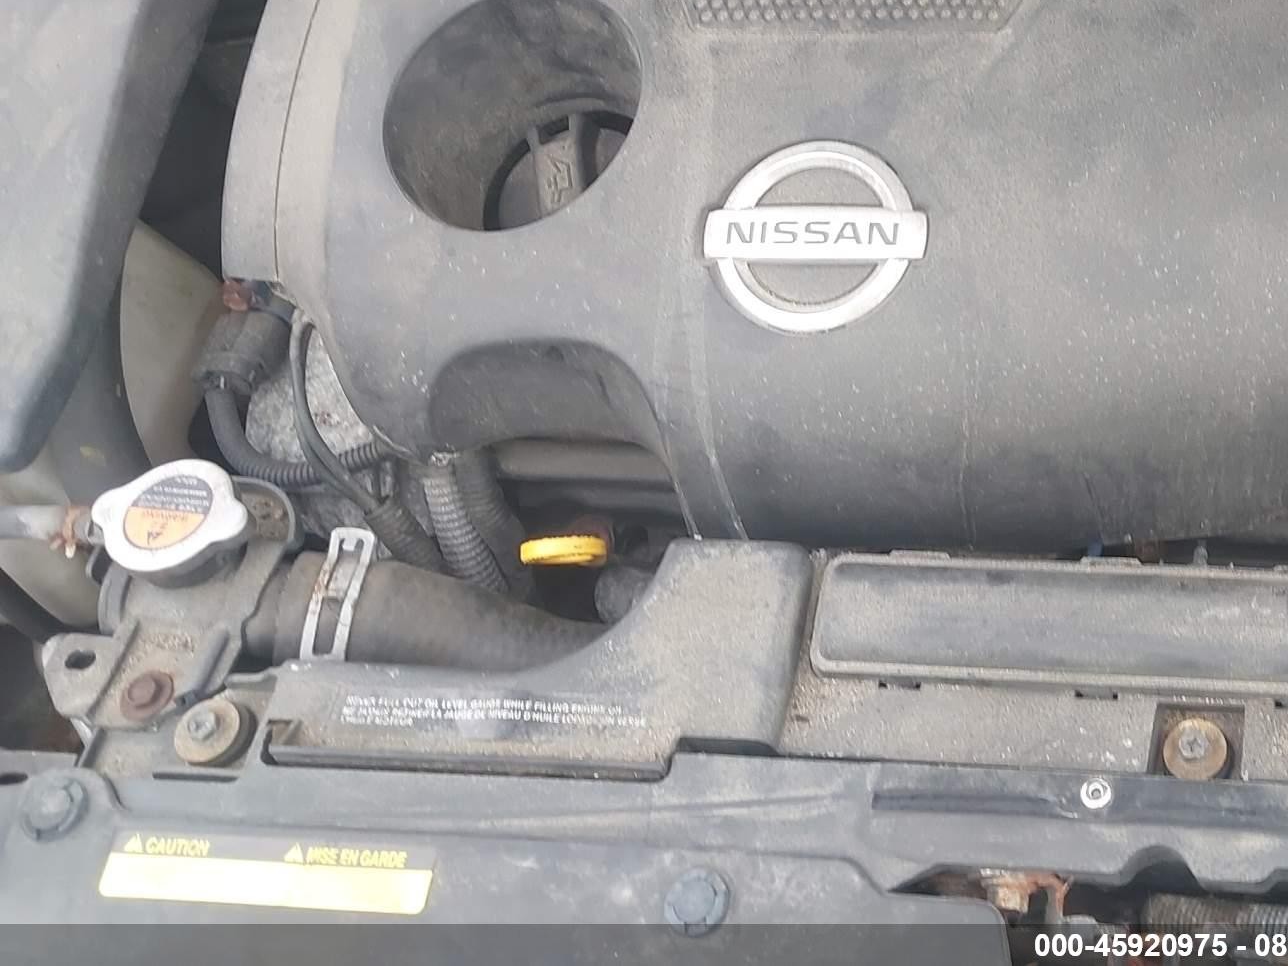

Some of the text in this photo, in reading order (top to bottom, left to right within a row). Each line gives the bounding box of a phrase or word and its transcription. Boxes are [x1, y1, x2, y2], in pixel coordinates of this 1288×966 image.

[726, 221, 899, 246] NISSAN
[145, 836, 210, 858] CAUTION
[306, 846, 407, 868] MISE EN GARDE
